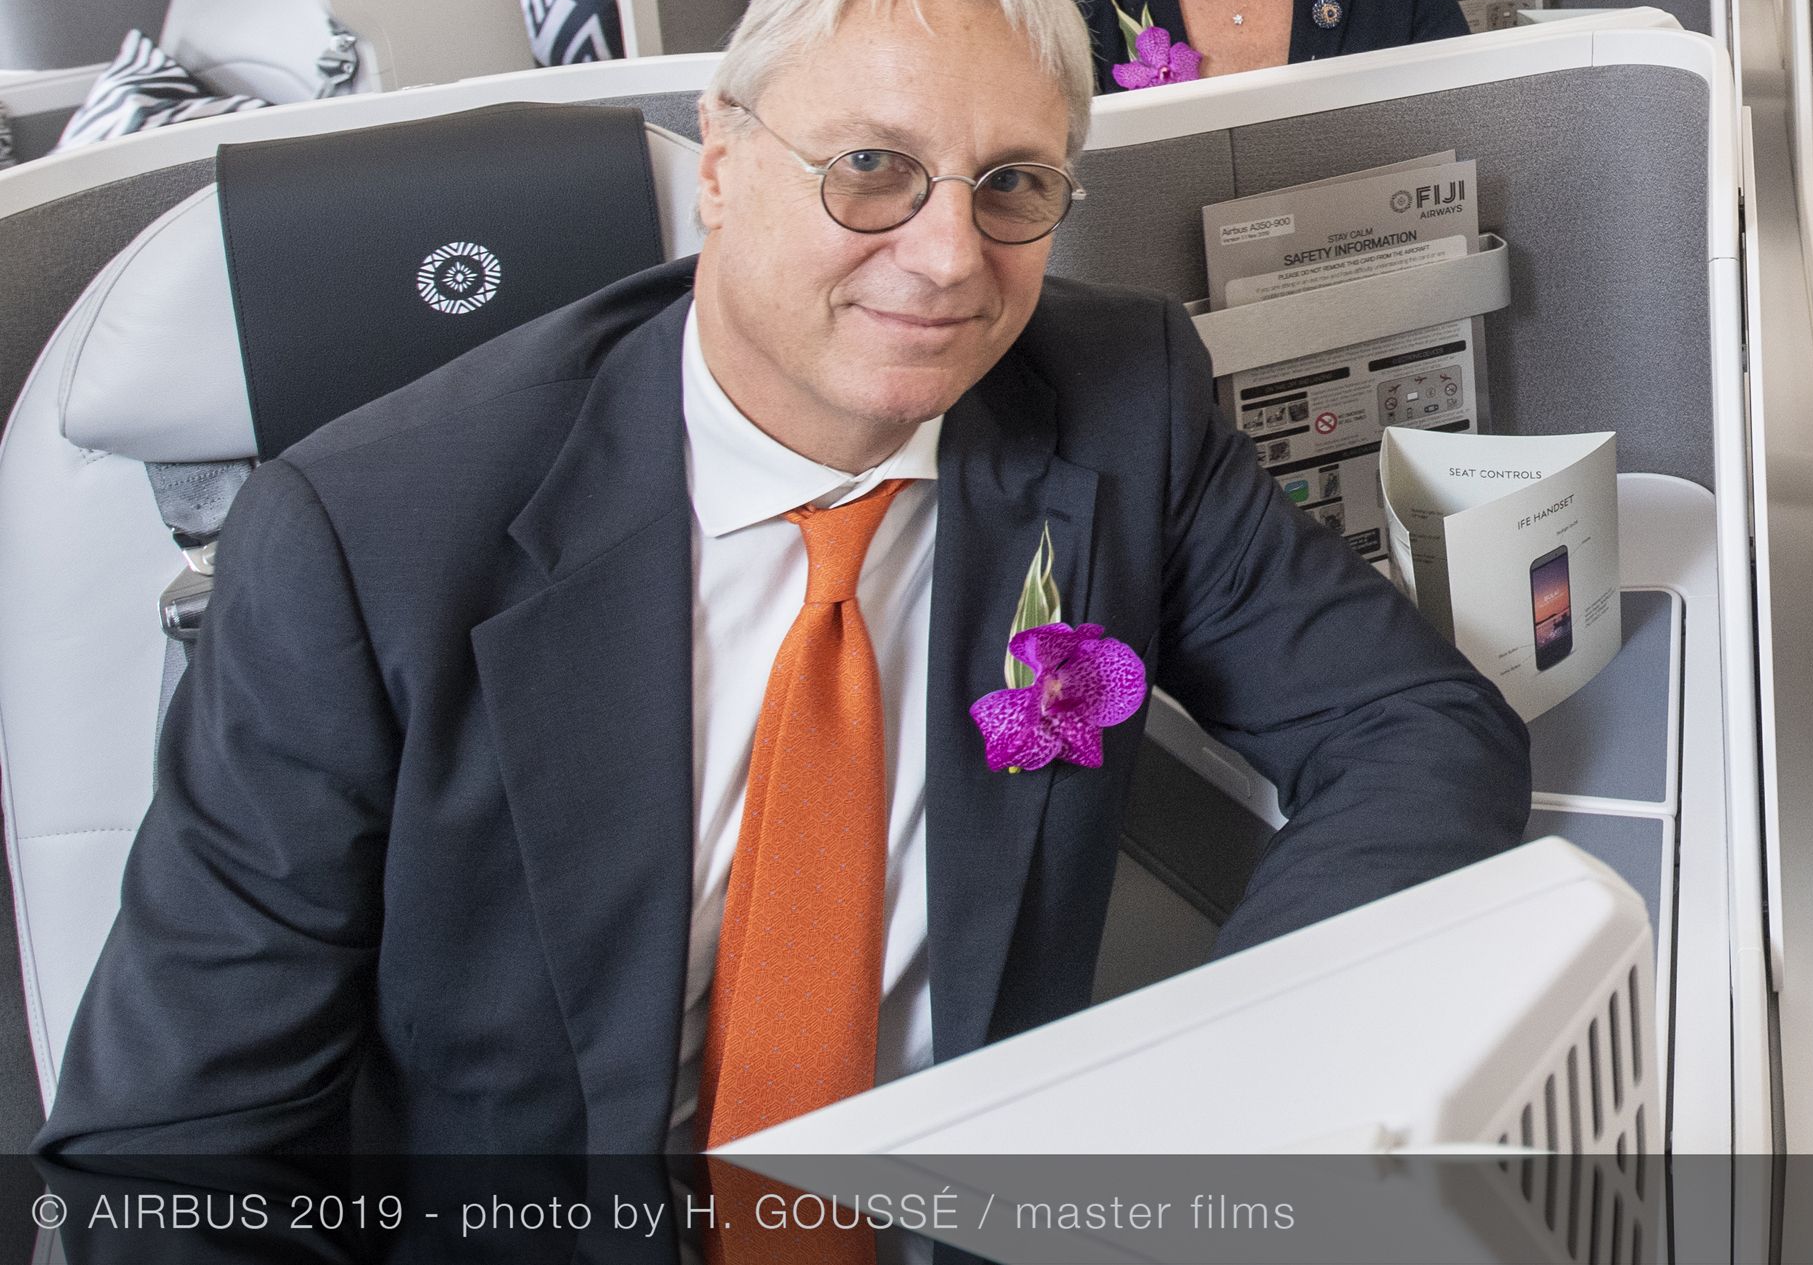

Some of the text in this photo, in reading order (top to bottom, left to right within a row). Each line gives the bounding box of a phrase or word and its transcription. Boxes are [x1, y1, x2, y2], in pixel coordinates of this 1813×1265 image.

[1416, 180, 1465, 208] FIJI
[1420, 204, 1463, 219] AIRWAYS
[1222, 217, 1290, 236] Airbus A350-900
[1328, 228, 1373, 243] STAY CALM
[1284, 230, 1417, 266] SAFETY INFORMATION
[1449, 468, 1542, 480] SEAT CONTROLS
[1517, 494, 1575, 530] IFE HANDSET
